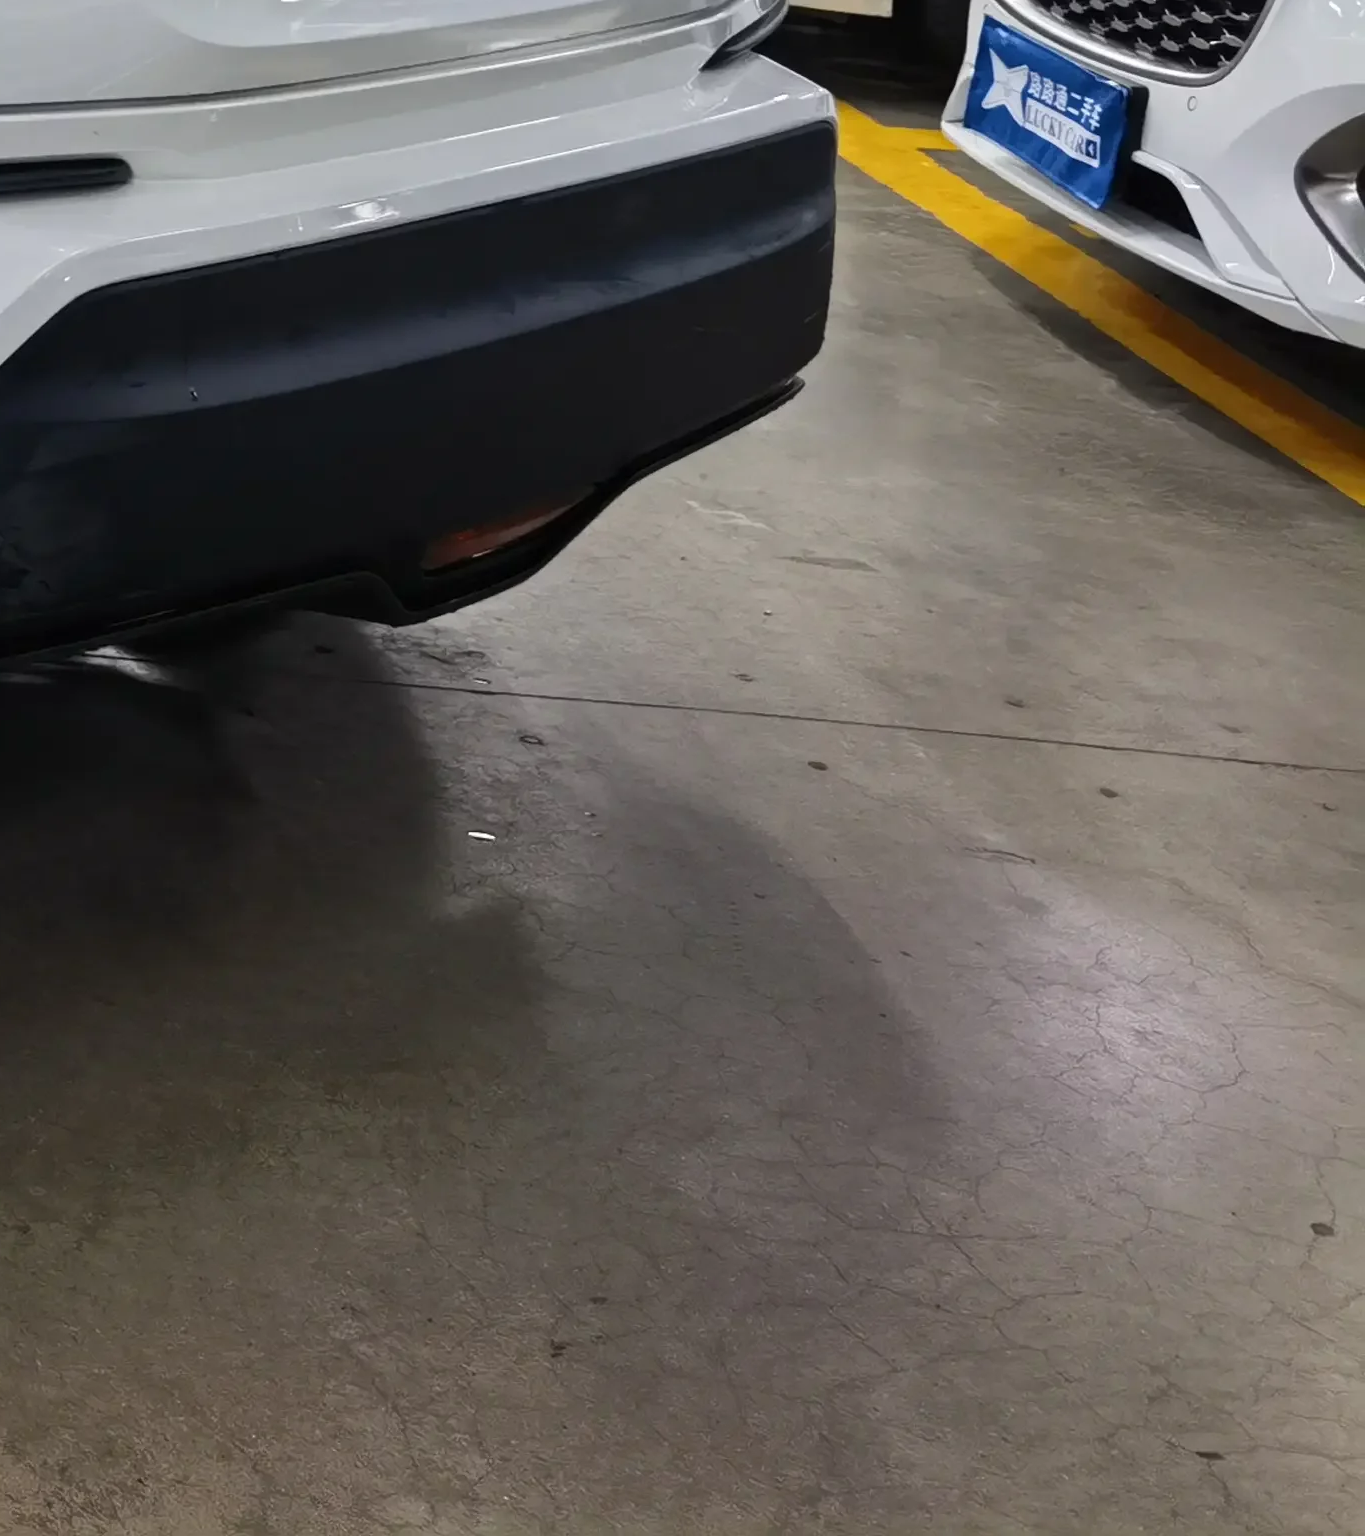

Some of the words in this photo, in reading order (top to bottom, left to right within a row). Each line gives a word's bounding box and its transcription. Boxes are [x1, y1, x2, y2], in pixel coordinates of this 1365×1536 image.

[1028, 71, 1102, 131] 路路通二手车
